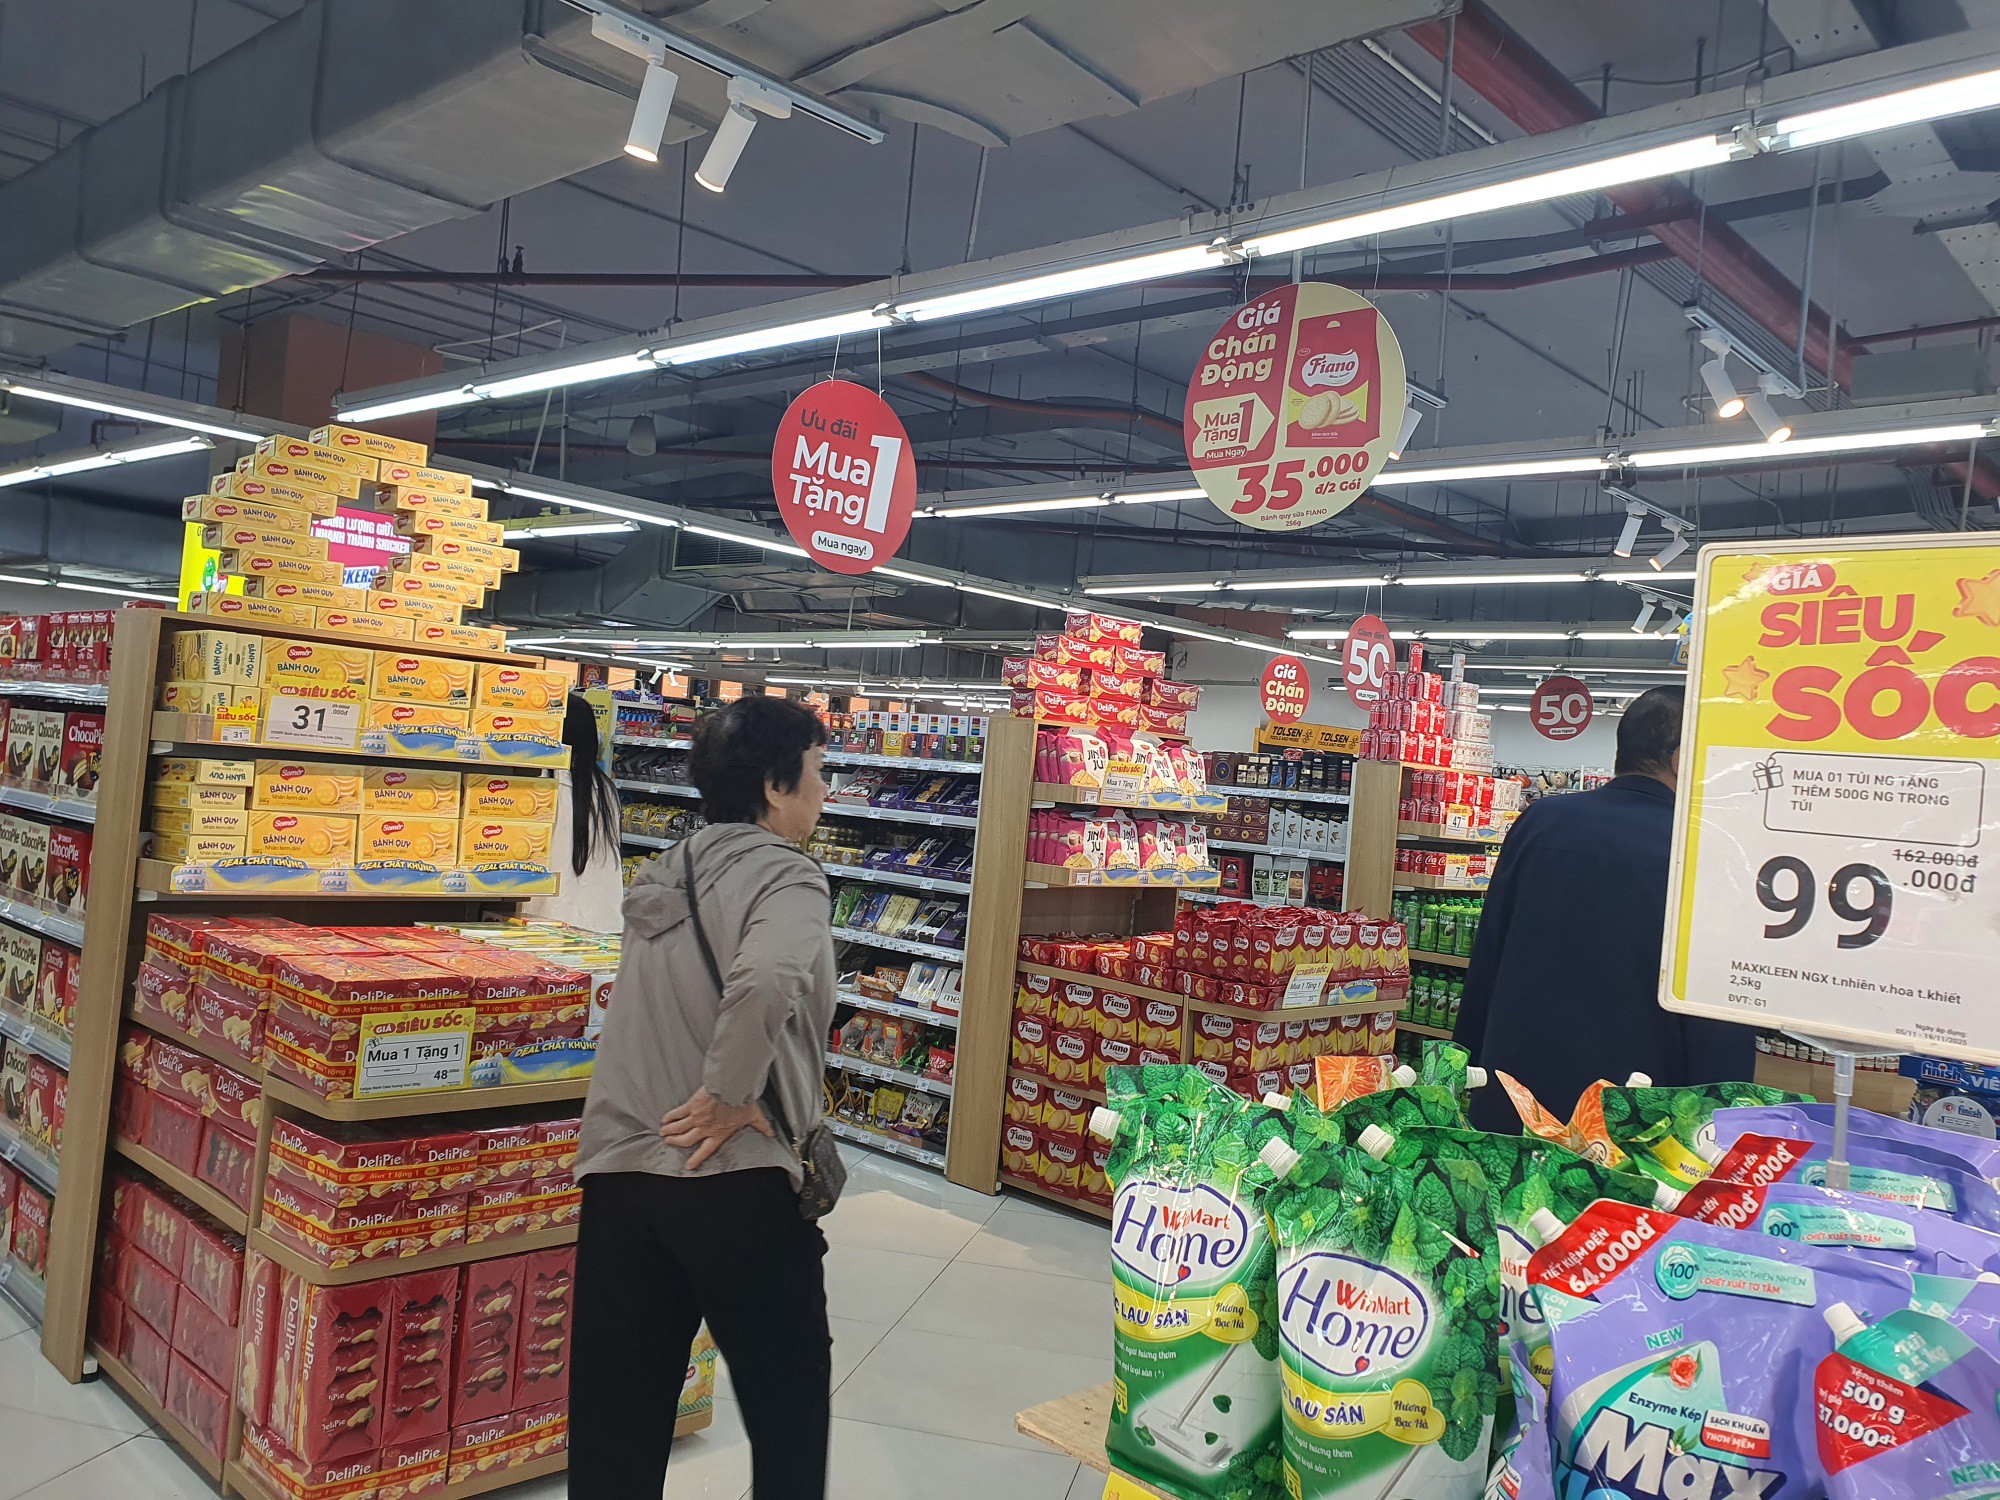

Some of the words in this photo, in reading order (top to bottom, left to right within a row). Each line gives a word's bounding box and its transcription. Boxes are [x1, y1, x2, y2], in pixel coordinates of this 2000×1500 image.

[1237, 300, 1281, 329] Giá
[1208, 327, 1277, 360] Chấn
[1201, 358, 1273, 388] Động
[801, 408, 827, 432] Ưu
[830, 418, 859, 440] đãi
[1204, 411, 1240, 428] Mua
[1238, 399, 1254, 443] 1
[1203, 427, 1239, 445] Tặng
[1206, 450, 1224, 460] Mua
[1225, 447, 1246, 459] Ngay
[793, 434, 871, 487] Mua
[863, 434, 902, 534] 1
[1230, 459, 1305, 515] 35
[1308, 451, 1370, 479] .000
[1340, 478, 1361, 492] Gói
[789, 473, 865, 525] Tặng
[1260, 513, 1277, 522] Bánh
[1278, 513, 1291, 522] quy
[1292, 511, 1305, 519] sữa
[1306, 508, 1327, 517] FIANO
[1285, 519, 1302, 528] 256g
[818, 535, 839, 550] Mua
[841, 542, 867, 555] ngay!
[1772, 565, 1823, 592] GIÁ
[1758, 584, 1915, 648] SIÊU
[1273, 663, 1297, 680] Giá
[1347, 639, 1389, 687] 50
[387, 674, 409, 685] BÁNH
[410, 677, 427, 688] QUY
[1265, 681, 1304, 699] Chấn
[1765, 629, 2000, 742] SỐC
[283, 687, 297, 695] GIÁ
[299, 685, 330, 698] SIÊU
[330, 685, 357, 699] SỐC
[490, 685, 510, 695] BÁNH
[511, 687, 527, 698] QUY
[217, 712, 237, 721] SIÊU
[238, 713, 256, 721] SỐC
[1265, 698, 1303, 718] Động
[291, 705, 326, 732] 31
[233, 731, 243, 739] 31
[1272, 725, 1302, 738] TOLSEN
[1319, 731, 1349, 743] TOLSEN
[1087, 748, 1100, 761] JIN
[281, 766, 306, 779] Somér
[1093, 759, 1105, 772] JU
[1793, 769, 1824, 783] MUA
[1828, 771, 1842, 784] 01
[1846, 770, 1870, 785] TÚI
[1874, 774, 1895, 787] NG
[1897, 773, 1939, 791] TẶNG
[269, 783, 294, 794] BÁNH
[295, 785, 313, 797] QUY
[374, 789, 396, 800] BÁNH
[397, 791, 414, 802] QUY
[1792, 783, 1831, 798] THÊM
[1834, 788, 1869, 800] 500G
[1873, 790, 1894, 802] NG
[1897, 791, 1949, 807] TRONG
[1790, 798, 1812, 813] TÚI
[274, 816, 299, 828] Somér
[1452, 815, 1462, 828] 47
[21, 831, 46, 854] ChocoPie
[262, 834, 287, 846] BÁNH
[288, 835, 306, 848] QUY
[1891, 848, 1980, 868] 162.000đ
[1902, 869, 1977, 893] .000đ
[1756, 855, 1893, 949] 99
[1067, 984, 1093, 998] Fiano
[1729, 974, 1762, 991] 2,5kg
[1731, 959, 1799, 980] MAXKLEEN
[1801, 971, 1829, 985] NGX
[1831, 974, 1876, 992] t.nhiên
[1879, 983, 1914, 1000] v.hoa
[1917, 986, 1962, 1005] t.khiết
[1104, 995, 1130, 1010] Fiano
[1728, 993, 1753, 1006] ĐVT:
[1754, 996, 1768, 1009] G1
[1148, 1003, 1176, 1018] Fiano
[376, 1023, 393, 1034] GIÁ
[396, 1015, 431, 1033] SIÊU
[432, 1010, 463, 1029] SỐC
[1204, 1015, 1232, 1030] Fiano
[1895, 1027, 1918, 1038] 05/11
[367, 1049, 398, 1062] Mua
[403, 1048, 410, 1060] 1
[416, 1044, 448, 1060] Tặng
[453, 1043, 459, 1055] 1
[1058, 1036, 1084, 1051] Fiano
[433, 1069, 448, 1080] 48
[1921, 1061, 1961, 1083] finish
[1958, 1105, 1982, 1119] finish
[428, 1147, 471, 1163] DeliPie
[417, 1202, 460, 1219] DeliPie
[349, 1212, 394, 1229] DeliPie
[1114, 1195, 1236, 1268] Home
[1805, 1231, 1824, 1243] CHIẾT
[1828, 1229, 1850, 1243] XUẤT
[1540, 1260, 1562, 1282] TIẾT
[1563, 1243, 1590, 1270] KIỆM
[1704, 1276, 1725, 1287] CHIẾT
[1726, 1277, 1748, 1291] XUẤT
[1337, 1279, 1410, 1315] WinMart
[1121, 1305, 1150, 1325] LAU
[1216, 1303, 1245, 1317] Hương
[1282, 1267, 1415, 1358] Home
[1214, 1317, 1231, 1330] Bạc
[1231, 1316, 1245, 1329] Hà
[1645, 1324, 1684, 1349] NEW
[1158, 1350, 1177, 1360] thơm
[1851, 1365, 1875, 1386] Tặng
[1876, 1377, 1904, 1398] thêm
[1289, 1392, 1322, 1419] LAU
[1323, 1402, 1365, 1424] SÀN
[1394, 1399, 1427, 1415] Hương
[1628, 1391, 1678, 1417] Enzyme
[1679, 1405, 1702, 1424] Kép
[1841, 1379, 1886, 1411] 500
[1888, 1405, 1906, 1425] g
[1394, 1416, 1412, 1429] Bạc
[1414, 1417, 1429, 1430] Hà
[1709, 1415, 1730, 1429] SẠCH
[1731, 1419, 1766, 1435] KHUẨN
[465, 1428, 505, 1447] DeliPie
[1705, 1431, 1731, 1446] THƠM
[1732, 1434, 1756, 1451] MỀM
[397, 1448, 441, 1468] DeliPie
[1333, 1447, 1353, 1458] thơm
[1573, 1406, 1781, 1500] Max
[325, 1463, 372, 1484] DeliPie
[1951, 1462, 2000, 1486] NEW
